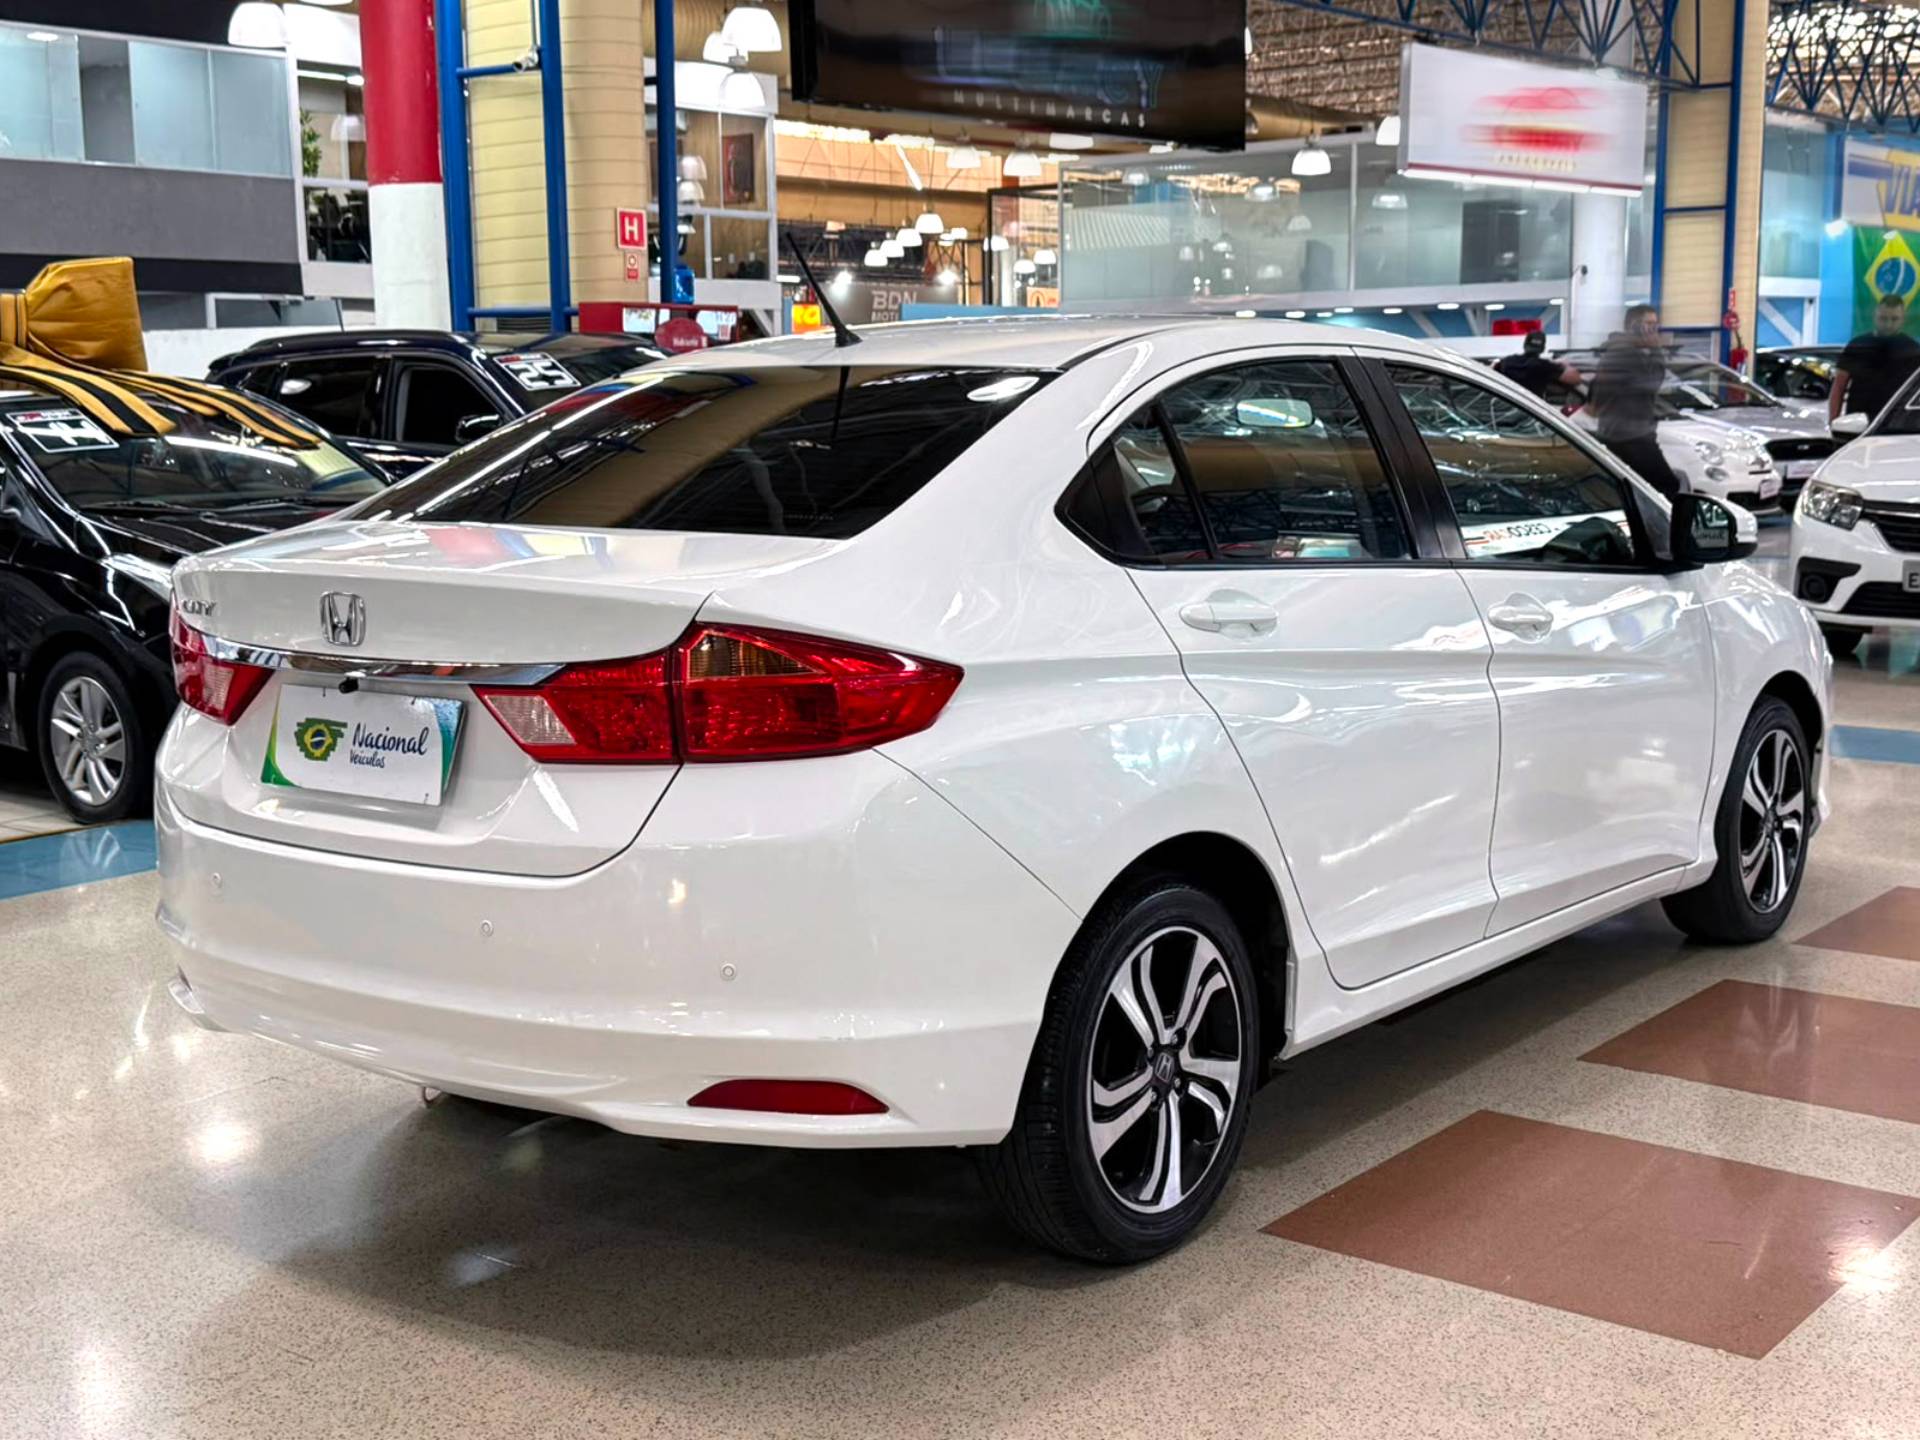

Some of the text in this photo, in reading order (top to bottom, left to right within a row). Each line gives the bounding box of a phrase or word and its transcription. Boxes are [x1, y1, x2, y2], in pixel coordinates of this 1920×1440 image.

[953, 89, 1146, 128] MULTIMARCAS
[624, 216, 640, 242] H
[508, 361, 574, 387] 25
[352, 722, 430, 756] Nacional
